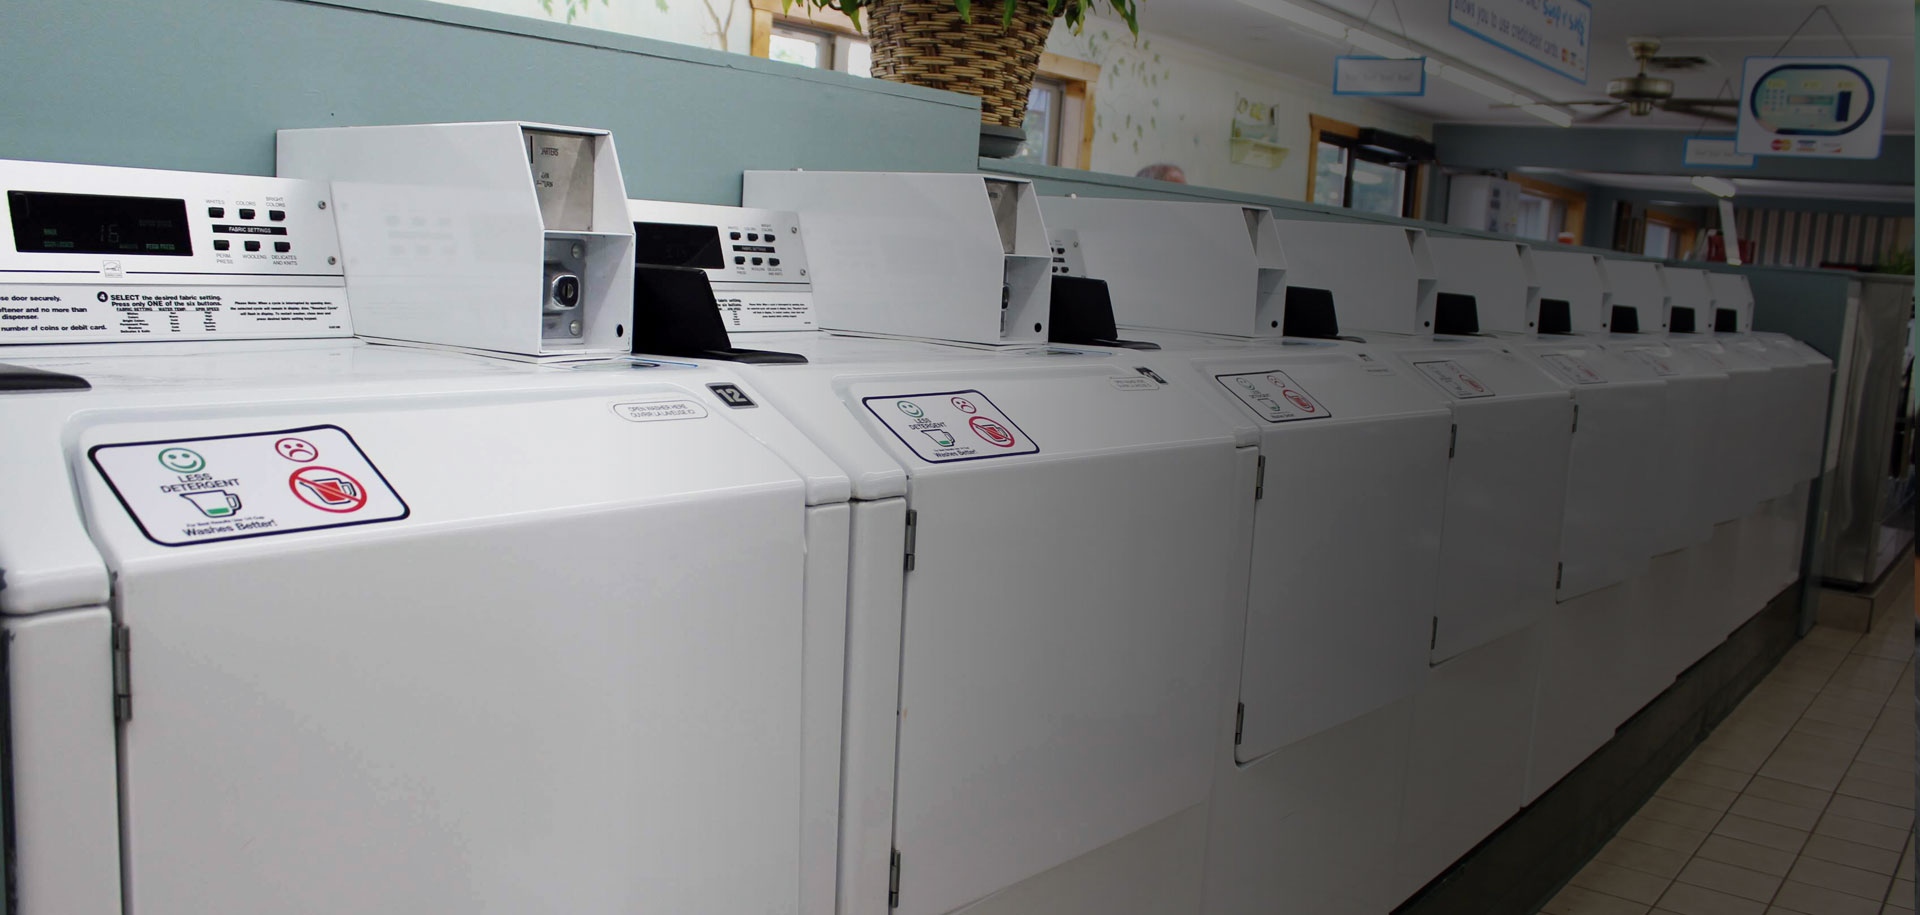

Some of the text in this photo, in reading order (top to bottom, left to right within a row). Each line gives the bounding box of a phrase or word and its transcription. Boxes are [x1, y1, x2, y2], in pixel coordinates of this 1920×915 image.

[30, 295, 62, 303] securely.
[715, 388, 748, 403] 12
[178, 472, 213, 483] LESS
[160, 478, 240, 493] DETERGENT
[183, 519, 278, 536] Washes Better!
